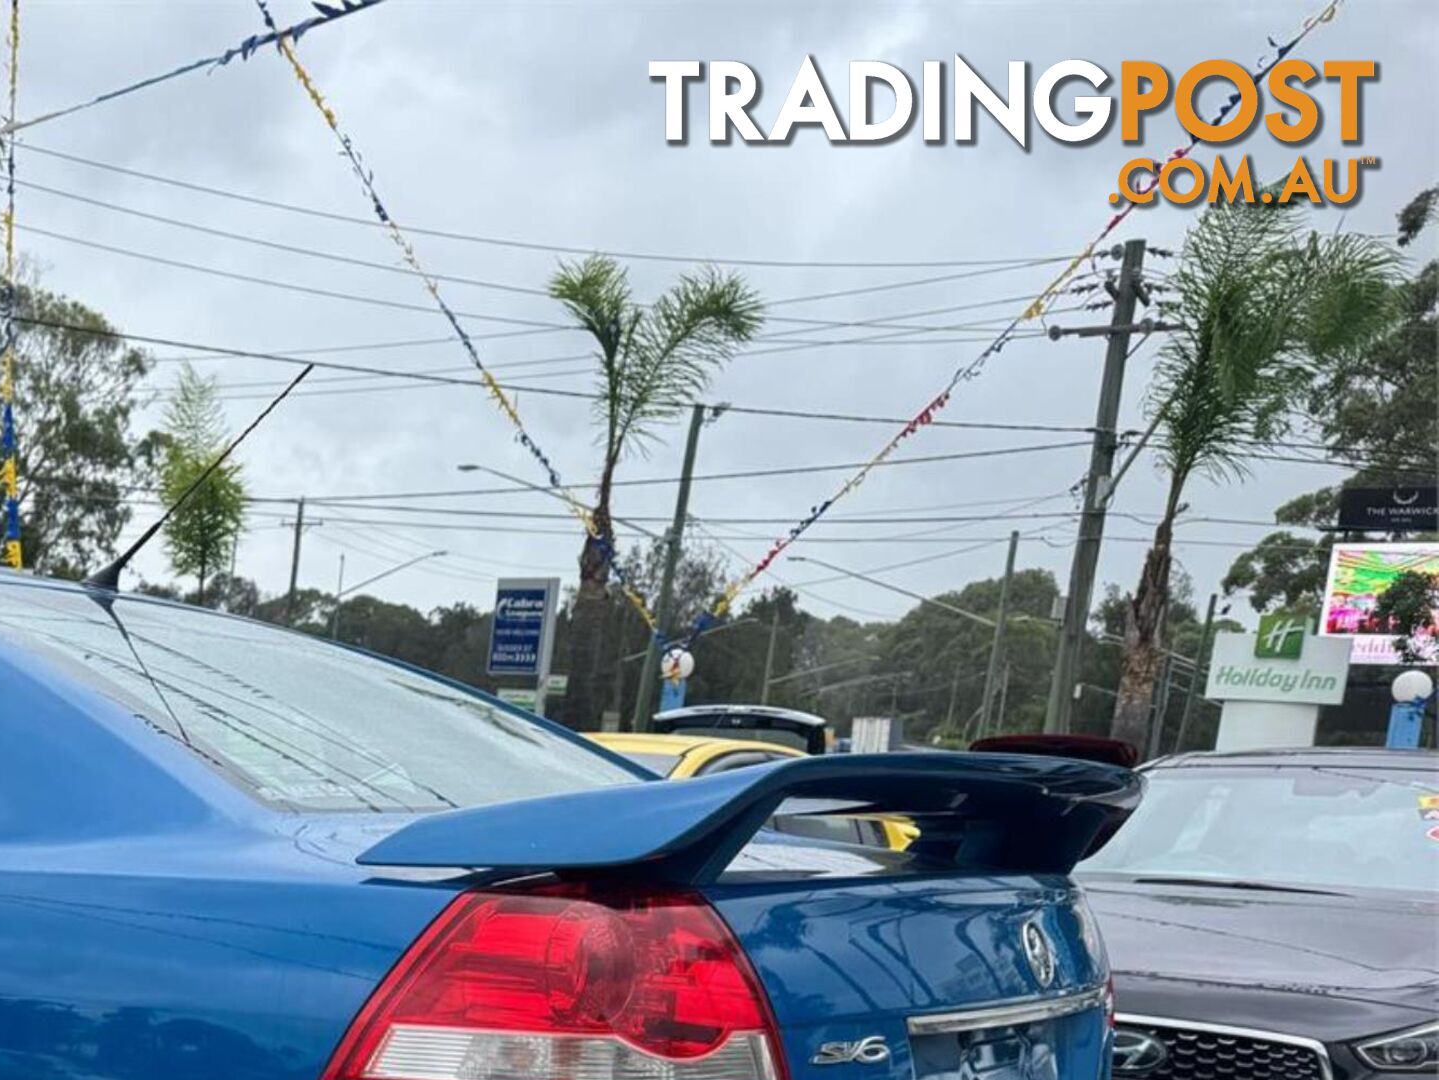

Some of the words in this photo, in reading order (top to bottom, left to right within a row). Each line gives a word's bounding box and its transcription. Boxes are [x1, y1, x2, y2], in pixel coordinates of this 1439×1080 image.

[1367, 507, 1386, 516] THE
[1215, 665, 1295, 692] Holiday
[1300, 671, 1337, 690] Inn
[812, 1035, 890, 1065] SV6
